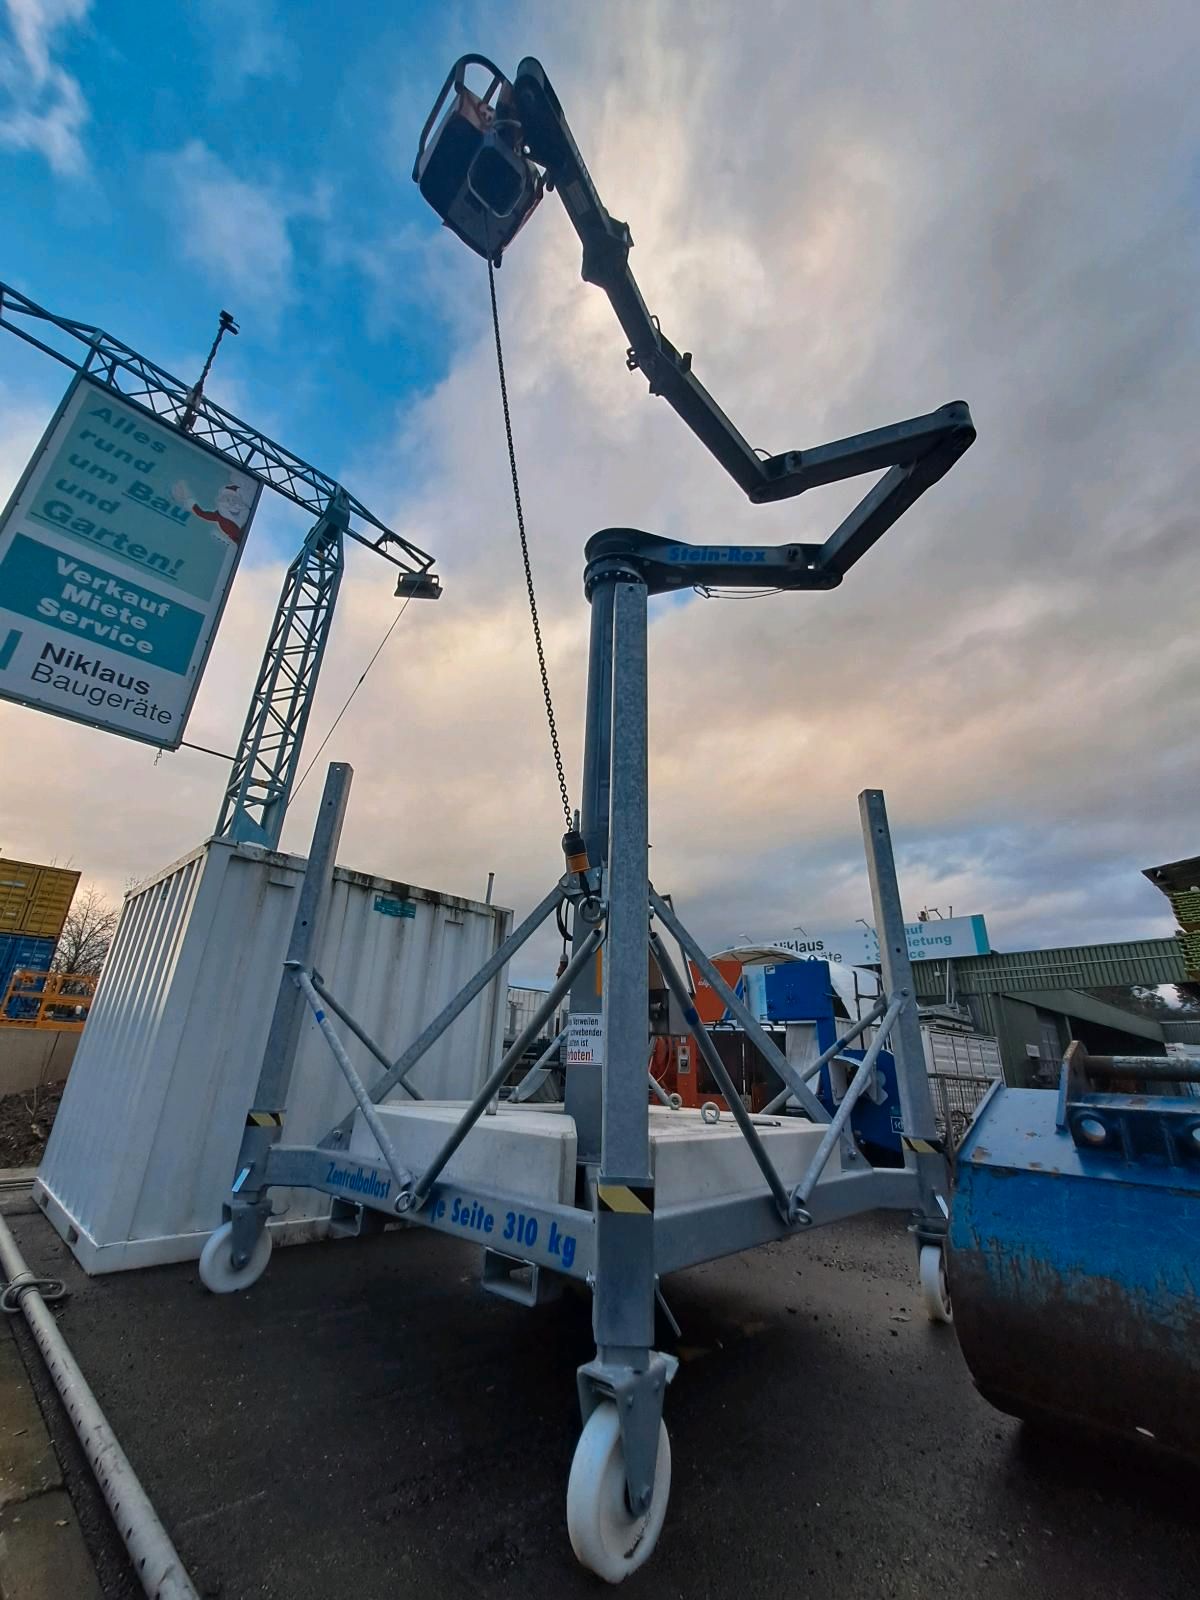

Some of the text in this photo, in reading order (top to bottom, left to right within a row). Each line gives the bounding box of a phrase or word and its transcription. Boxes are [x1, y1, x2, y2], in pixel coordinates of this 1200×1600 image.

[79, 429, 155, 474] rund
[88, 405, 167, 454] Alles
[55, 477, 119, 514] und
[68, 453, 193, 522] um Bau
[43, 501, 183, 575] Garten!
[668, 546, 767, 562] Stein-Rex
[56, 556, 170, 618] Verkauf
[61, 584, 147, 630] Miete
[36, 598, 154, 655] Service
[30, 662, 172, 725] Baugeräte
[40, 642, 151, 695] Niklaus
[581, 1038, 589, 1047] ist
[326, 1161, 391, 1199] Zentralballast
[451, 1197, 494, 1233] Seite
[503, 1211, 538, 1247] 310
[548, 1221, 577, 1268] kg
